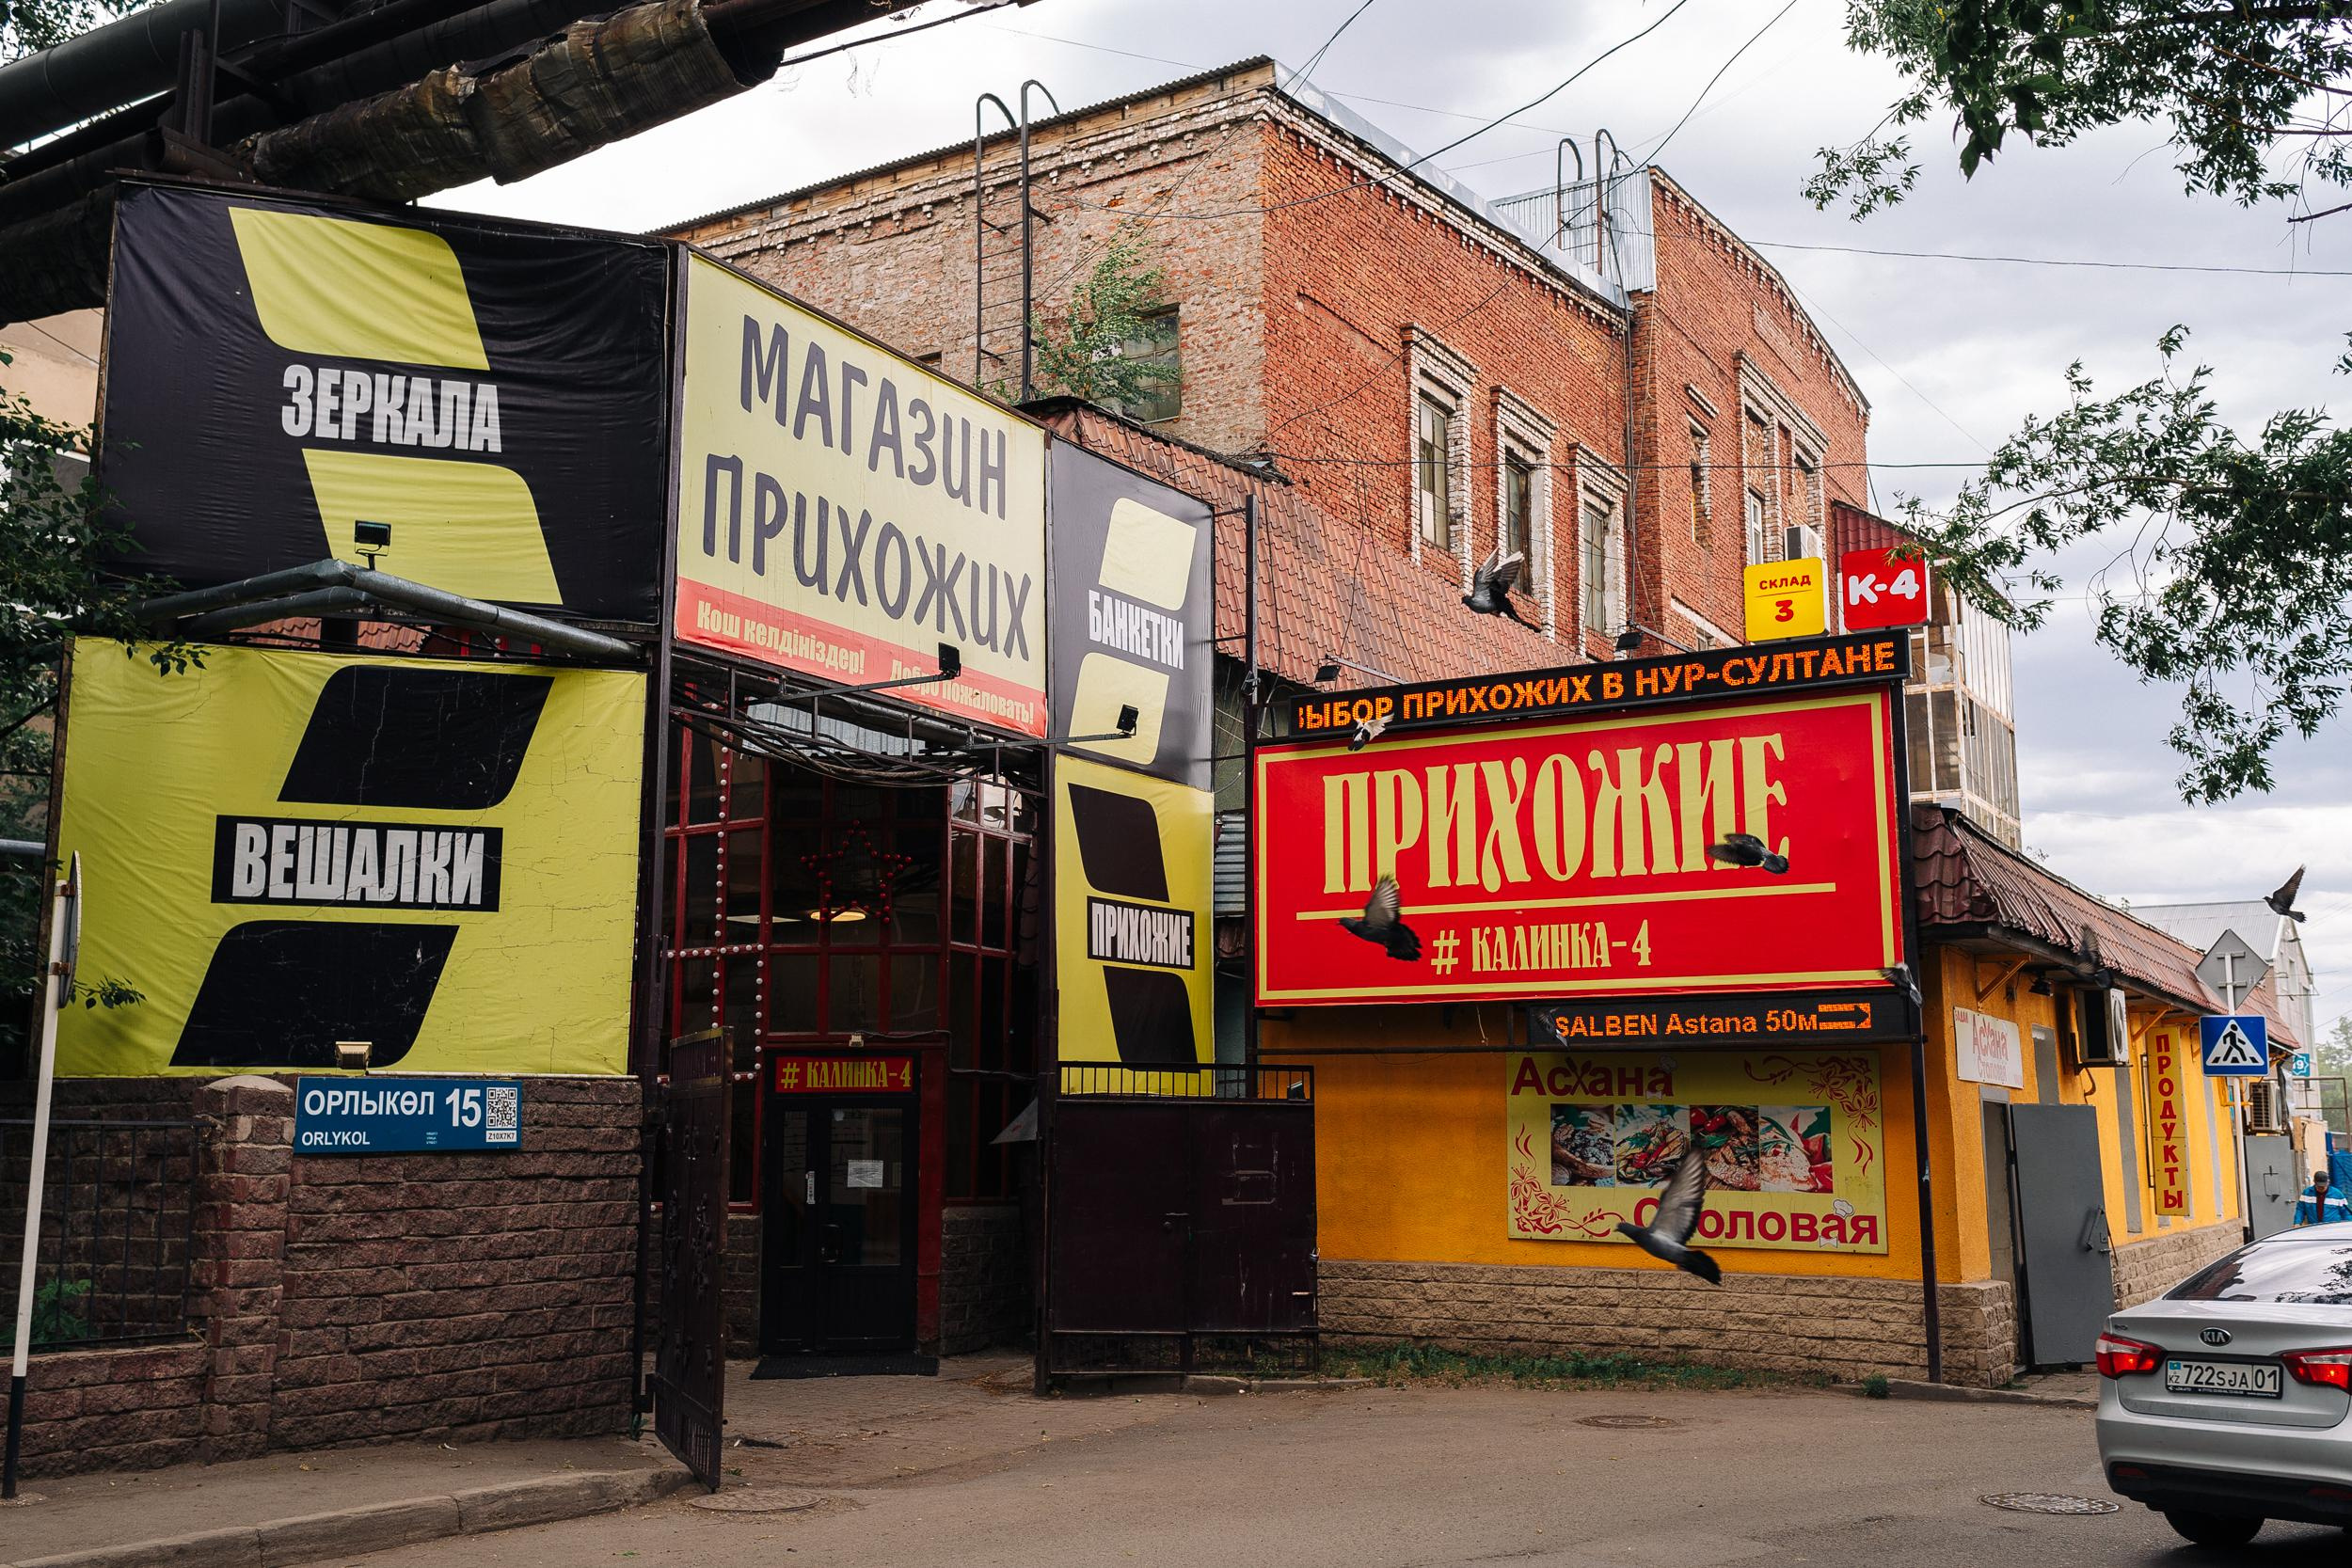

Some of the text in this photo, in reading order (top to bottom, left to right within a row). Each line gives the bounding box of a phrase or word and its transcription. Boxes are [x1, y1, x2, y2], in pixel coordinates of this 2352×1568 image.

[281, 363, 502, 452] ЗЕРКАЛА
[739, 314, 1007, 520] МАГАЗИН
[703, 452, 1032, 662] ПРИХОЖИХ
[1758, 574, 1812, 591] СКЛАД
[1848, 568, 1920, 606] К-4
[696, 600, 740, 639] Кош
[1089, 589, 1184, 670] БАНКЕТКИ
[1774, 599, 1794, 623] 3
[943, 674, 1035, 724] пожаловать!
[1403, 673, 1594, 720] ПРИХОЖИХ
[1602, 671, 1625, 701] В
[1634, 641, 1895, 697] НУР-СУЛТАНЕ
[1322, 732, 1789, 895] ПРИХОЖИЕ
[231, 821, 485, 905] ВЕШАЛКИ
[1091, 902, 1191, 966] ПРИХОЖИЕ
[1471, 919, 1653, 974] КАЛИНКА-4
[1555, 1013, 1658, 1037] SALBEN
[1664, 1012, 1758, 1036] Astana
[806, 1061, 912, 1088] КАЛИНКА-4
[1511, 1055, 1675, 1098] Асхана
[304, 1087, 482, 1127] ОРЛЫКӨЛ 15
[2155, 1035, 2183, 1209] ПРОДУКТЫ
[301, 1131, 371, 1146] ORLYKOL
[487, 1132, 516, 1141] Z10X7K7
[1633, 1196, 1879, 1245] Соловая
[2202, 1330, 2226, 1343] KIA
[2169, 1375, 2180, 1384] KZ
[2254, 1368, 2279, 1391] 01
